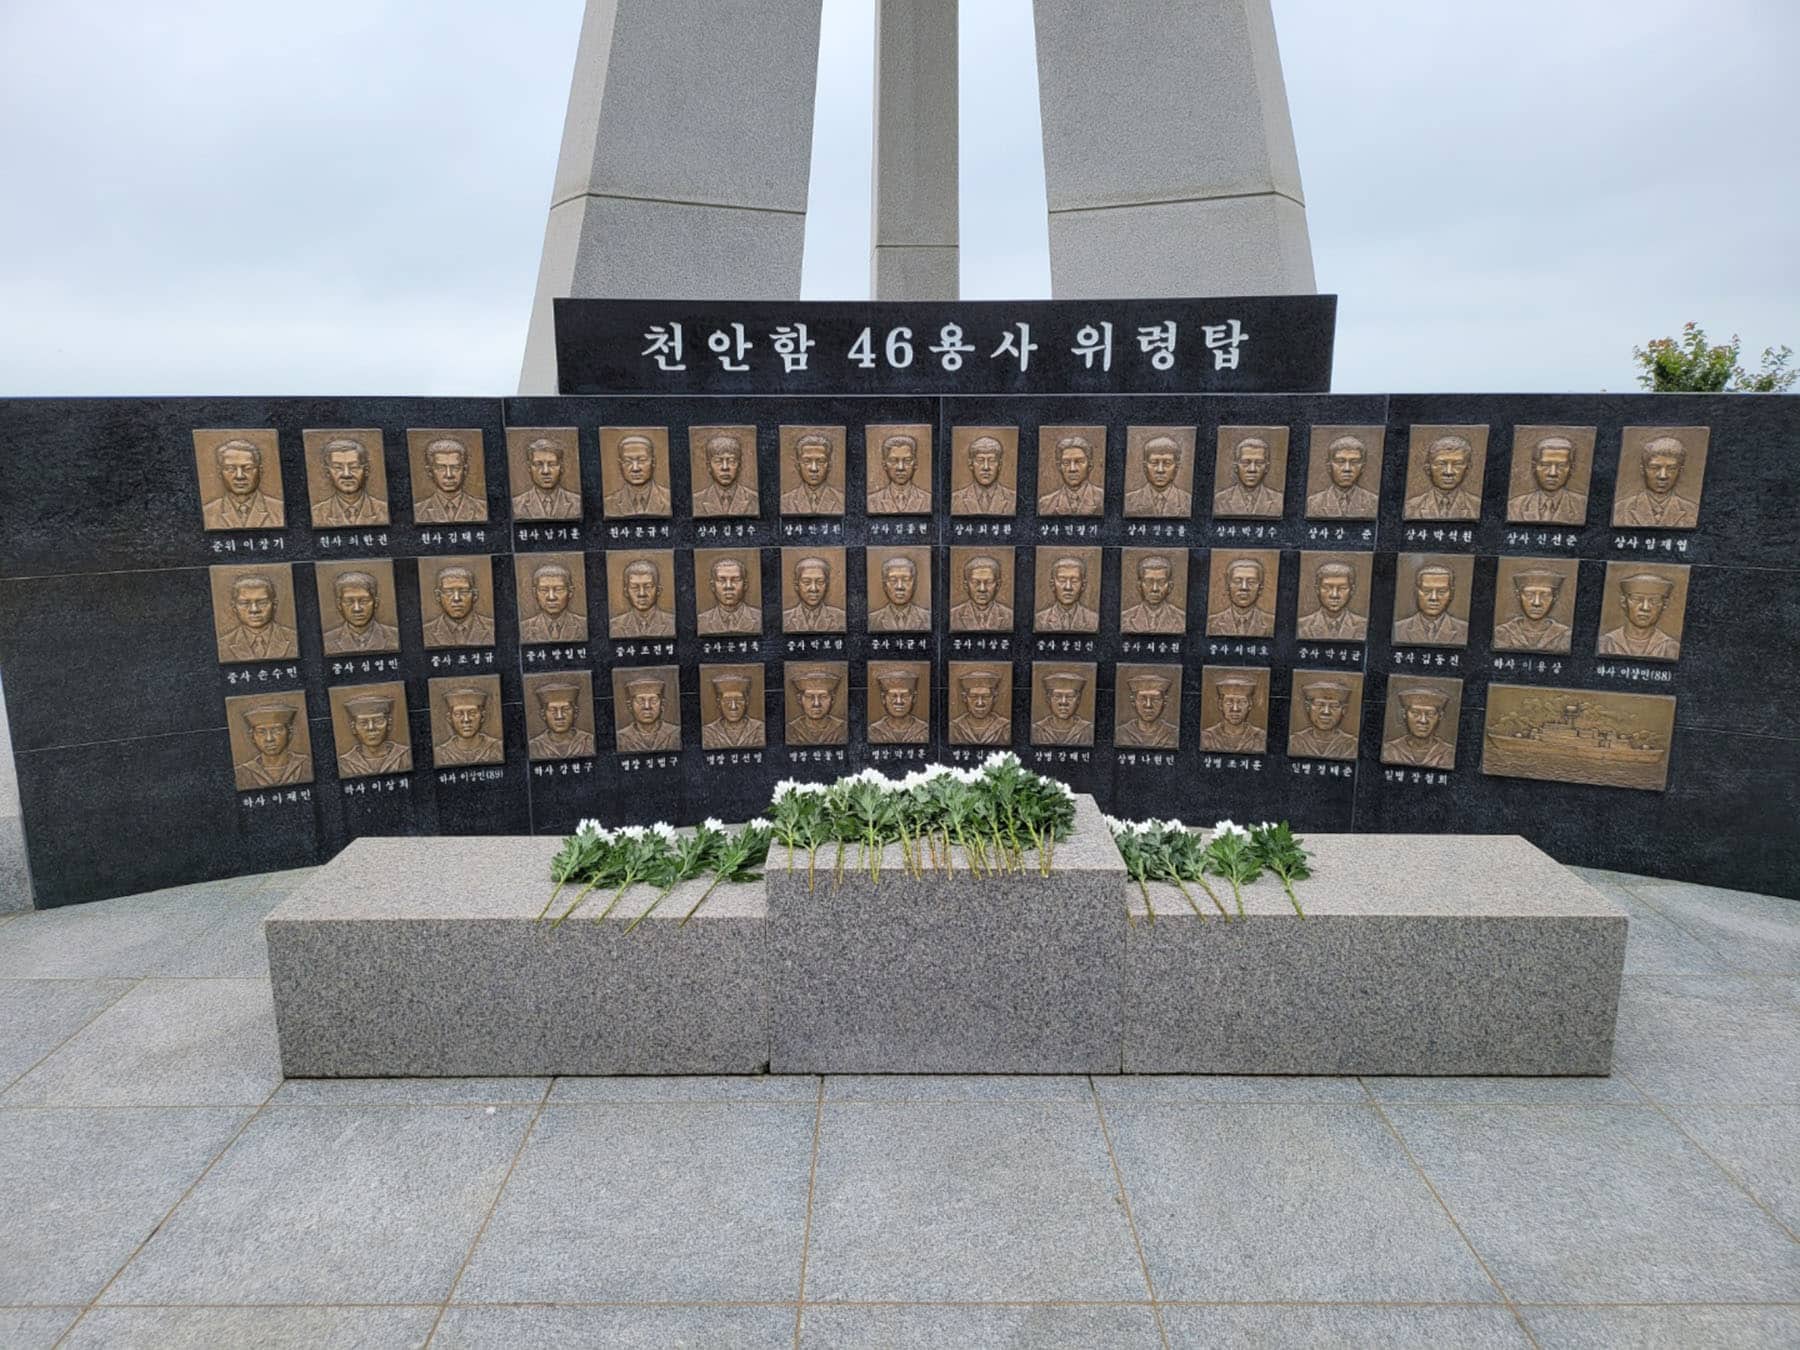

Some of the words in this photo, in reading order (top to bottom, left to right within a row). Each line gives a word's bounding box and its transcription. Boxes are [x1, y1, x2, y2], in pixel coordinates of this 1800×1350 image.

[641, 321, 816, 374] 천안함
[847, 321, 1039, 372] 46용사
[1070, 319, 1250, 372] 위령탑
